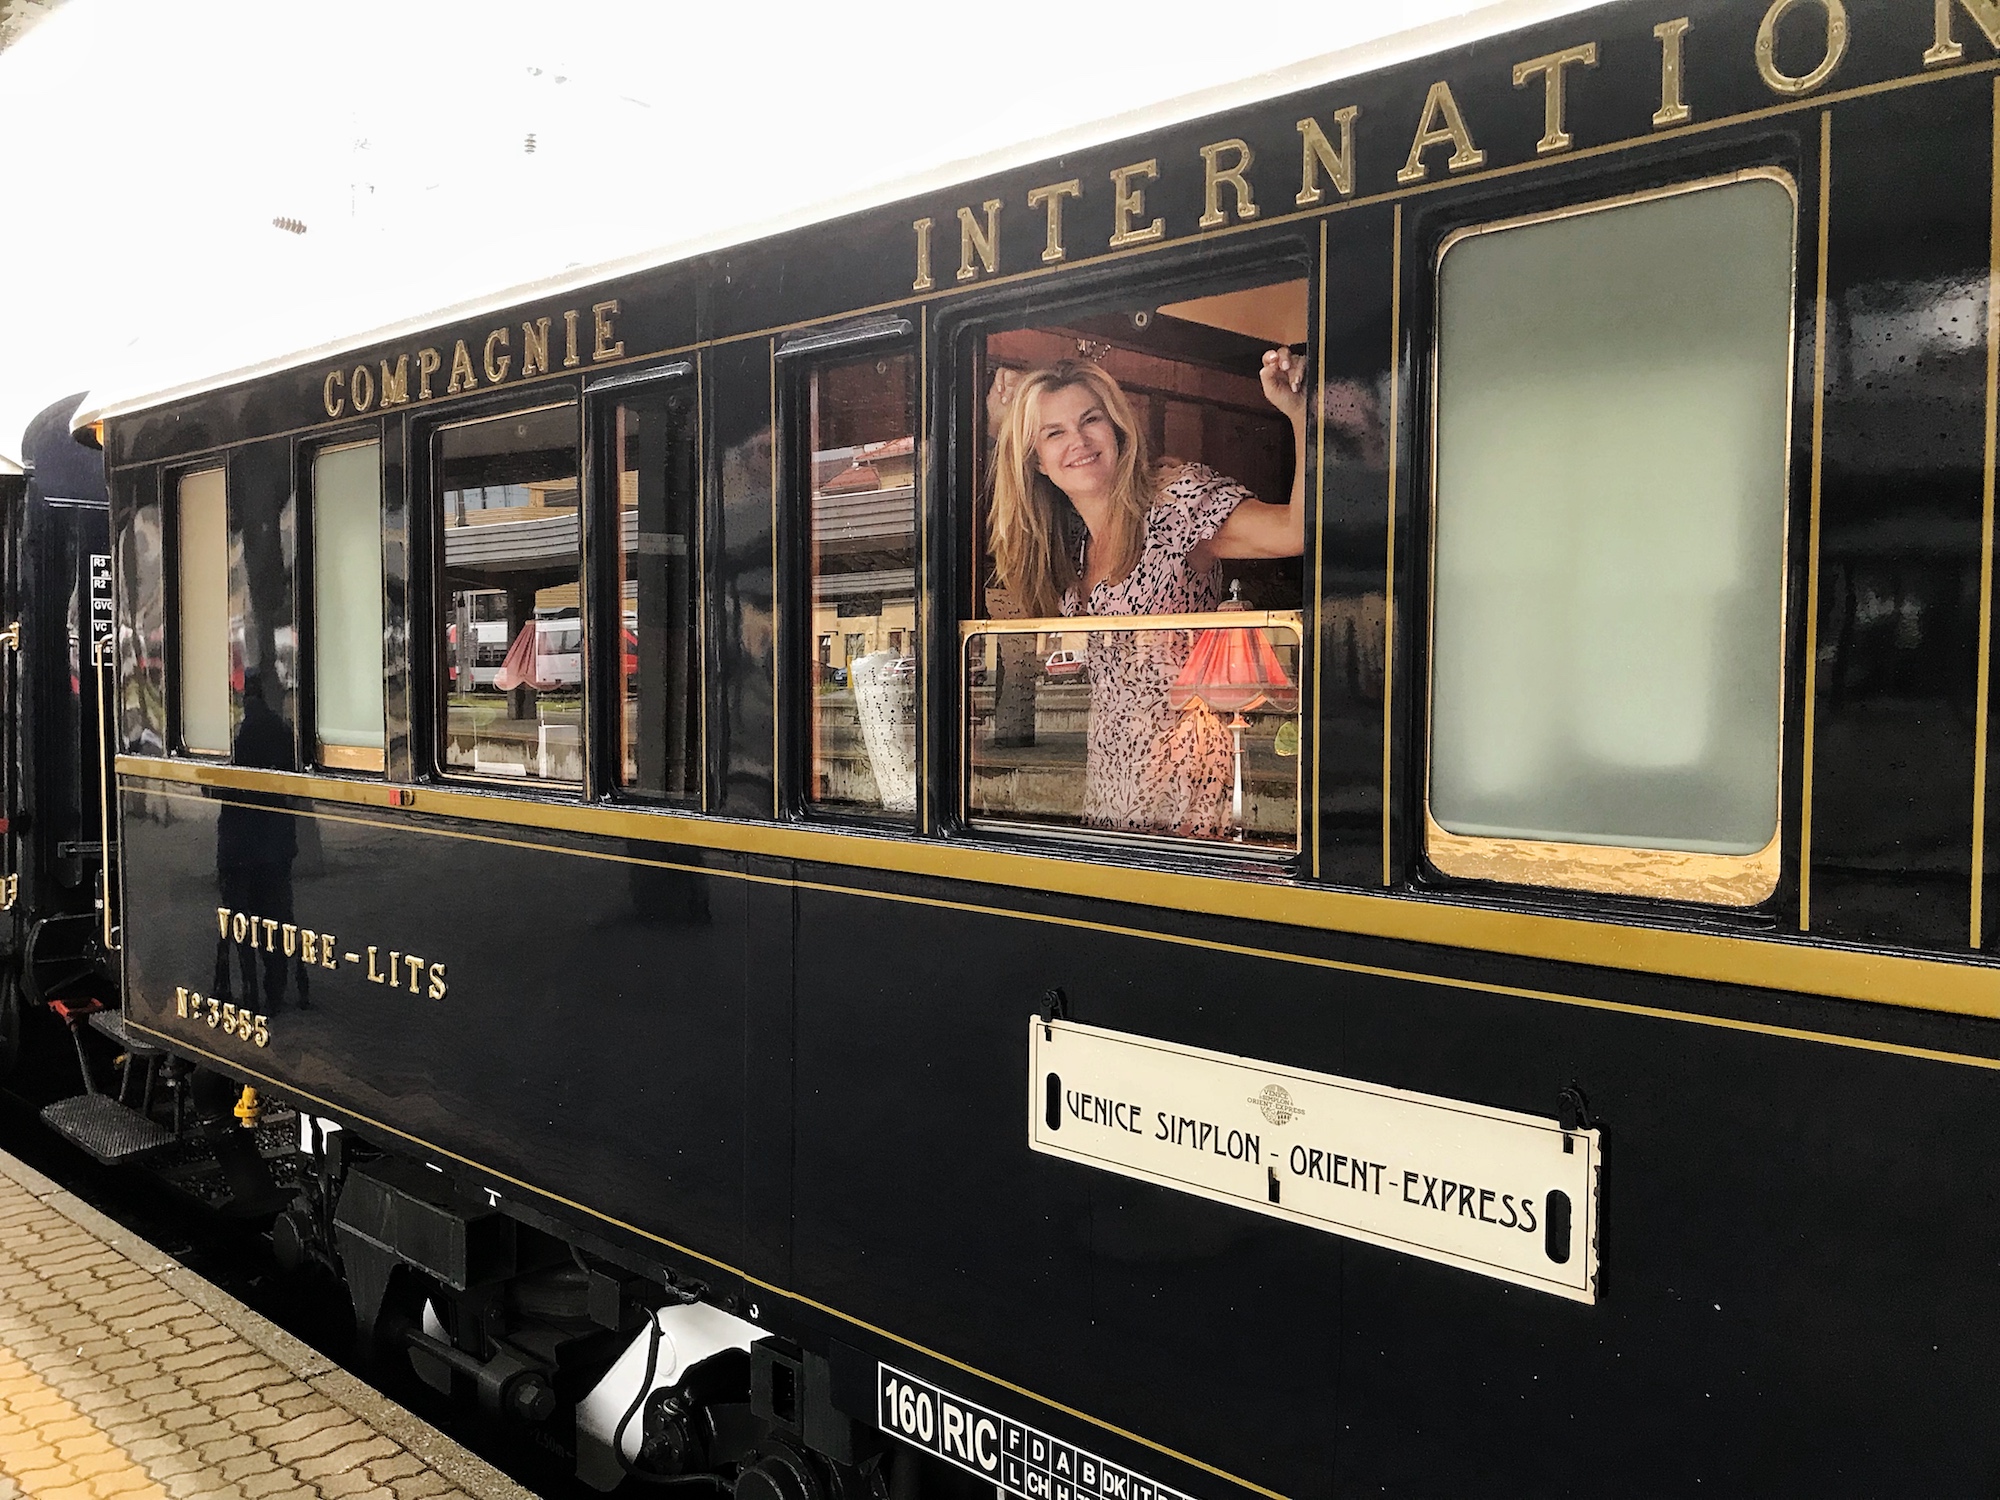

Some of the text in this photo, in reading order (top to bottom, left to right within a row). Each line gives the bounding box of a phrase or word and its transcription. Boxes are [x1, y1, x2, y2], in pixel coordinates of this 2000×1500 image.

[323, 300, 625, 417] COMPAGNIE
[93, 558, 106, 567] R3
[94, 580, 106, 589] R2
[94, 623, 107, 631] VC
[217, 906, 447, 1000] VOITURE-LITS
[1067, 1091, 1142, 1134] VENICE
[1155, 1112, 1260, 1165] SIMPLON
[1290, 1145, 1538, 1233] ORIENT-EXPRESS
[885, 1378, 998, 1471] 160 RIC
[1010, 1429, 1020, 1449] F
[1033, 1439, 1045, 1462] D
[1056, 1451, 1070, 1475] A
[1083, 1461, 1096, 1485] B
[1103, 1470, 1127, 1500] DK
[1010, 1462, 1020, 1485] L
[1027, 1472, 1049, 1499] CH
